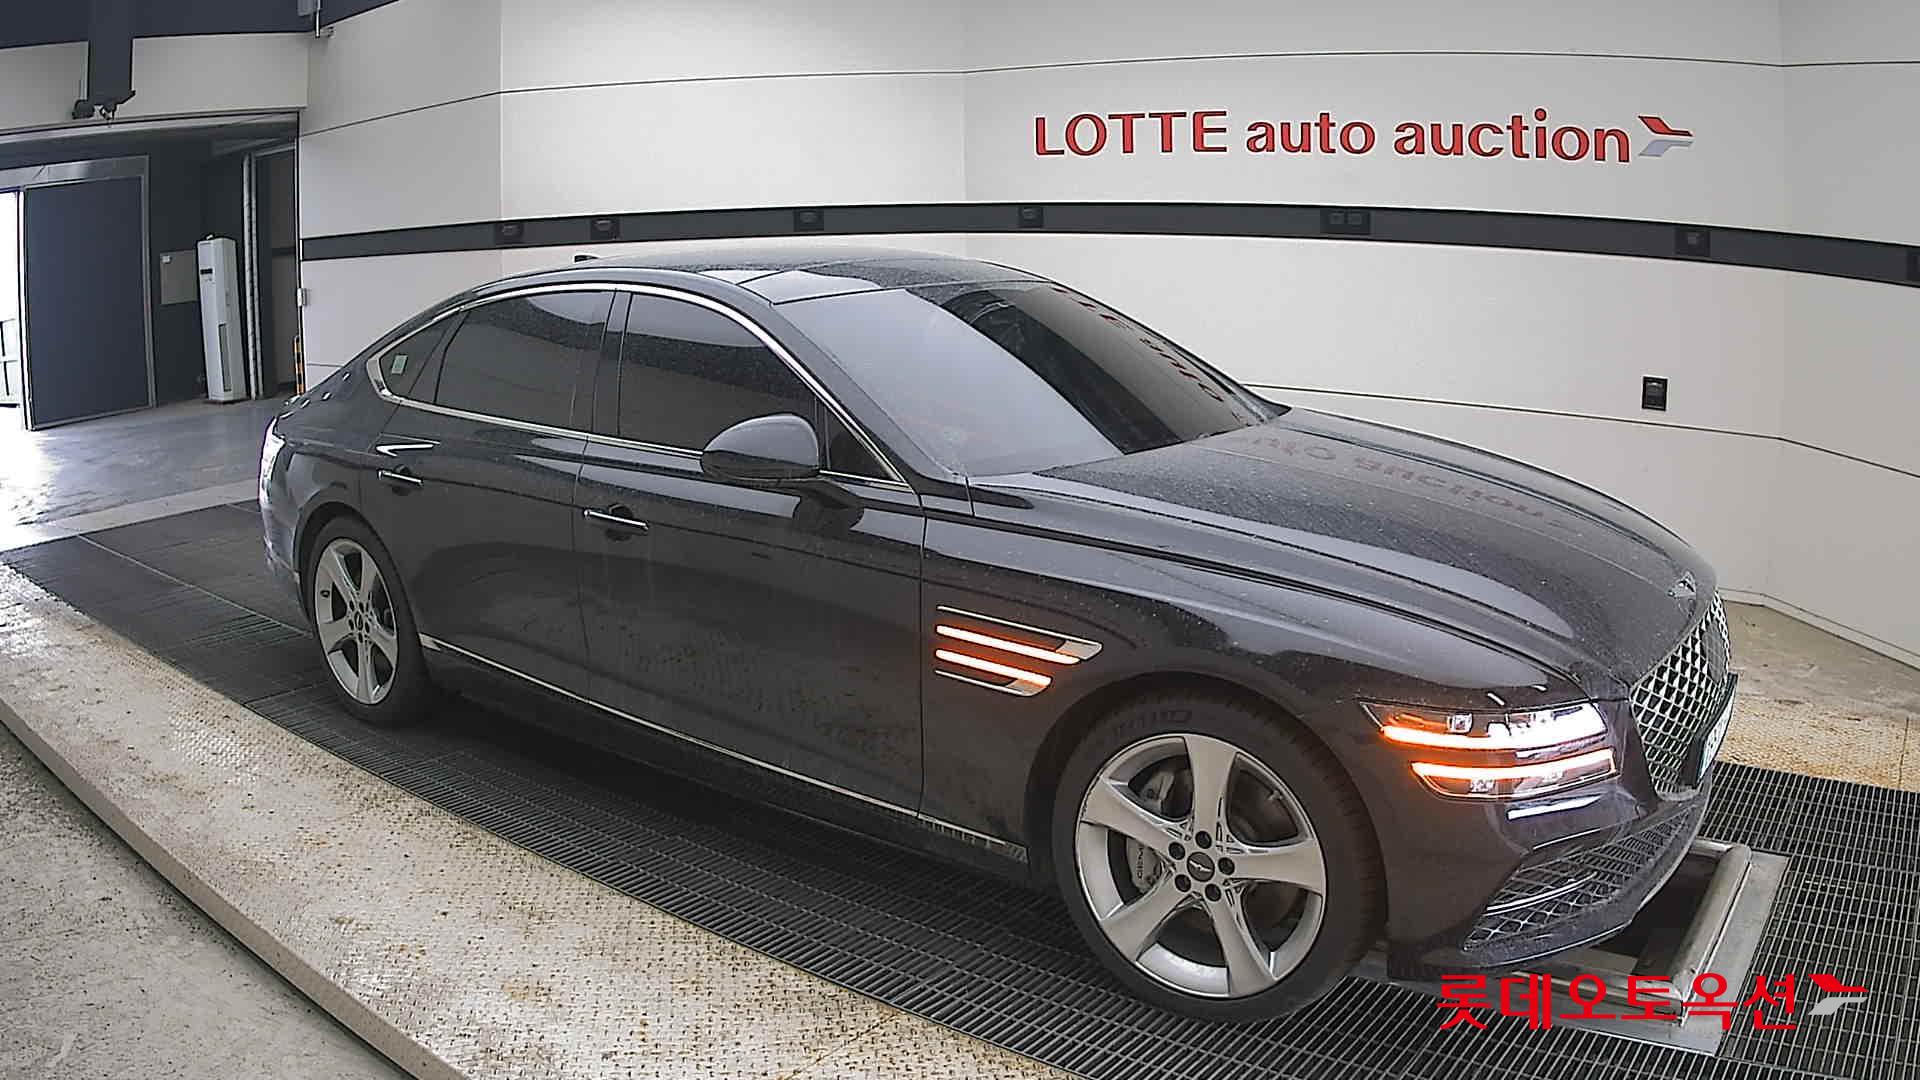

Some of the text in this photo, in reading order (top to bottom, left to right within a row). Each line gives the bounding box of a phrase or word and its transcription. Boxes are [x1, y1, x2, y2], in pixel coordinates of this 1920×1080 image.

[1035, 109, 1631, 162] LOTTE auto auction
